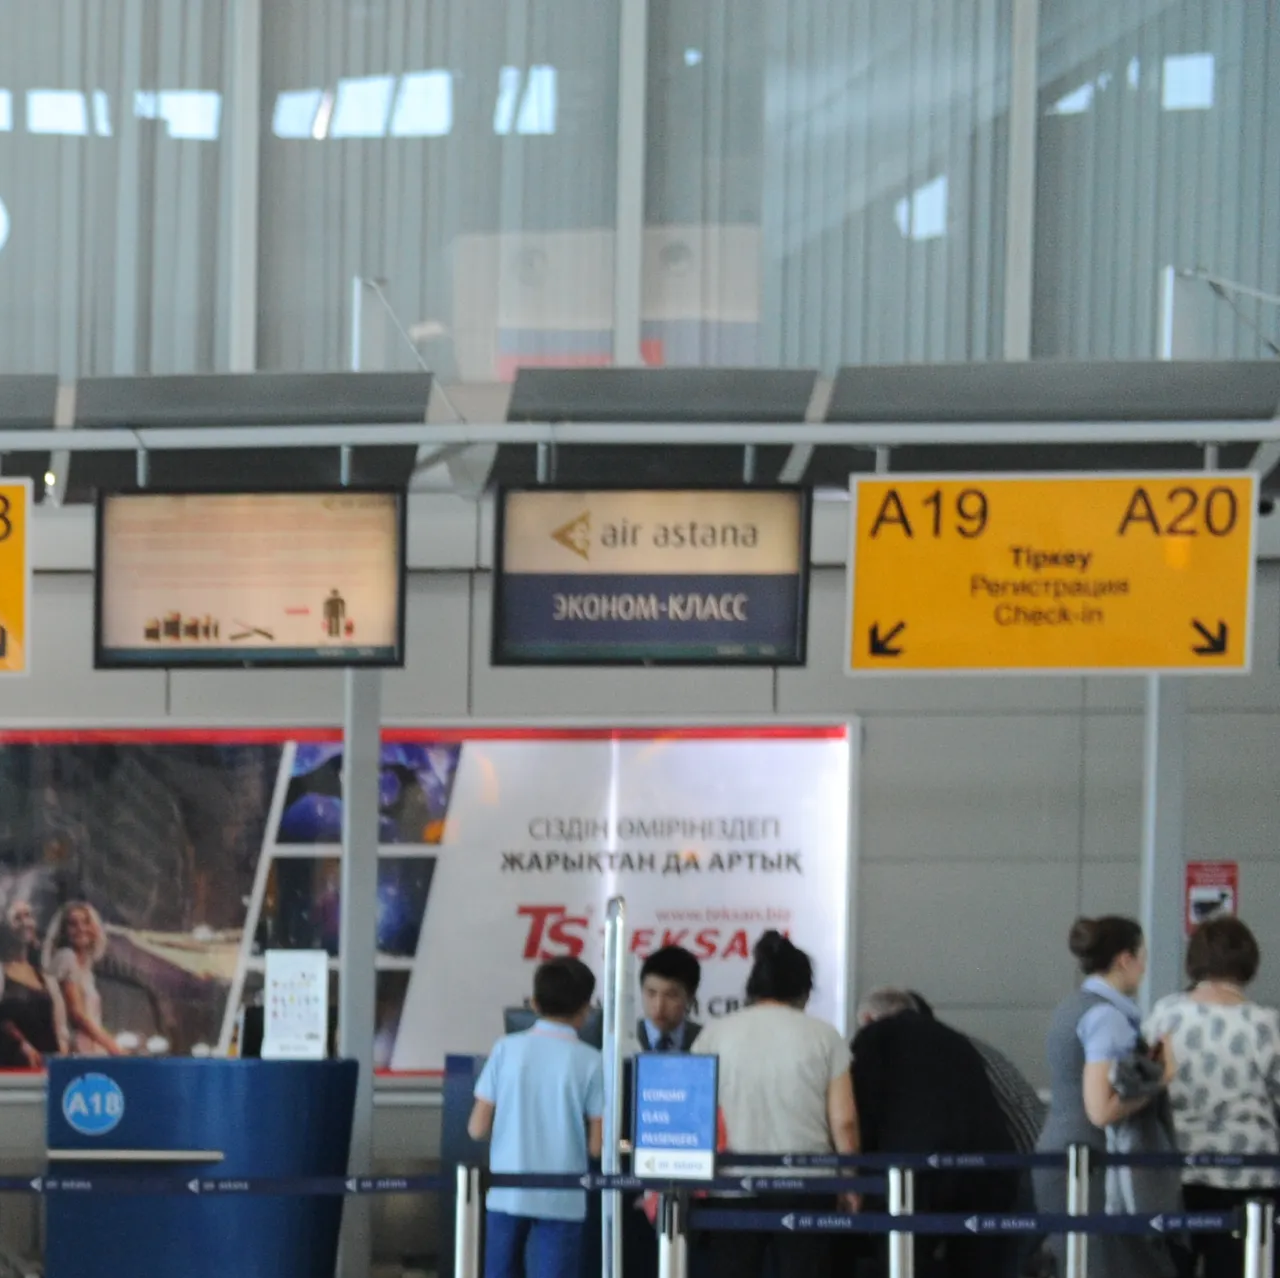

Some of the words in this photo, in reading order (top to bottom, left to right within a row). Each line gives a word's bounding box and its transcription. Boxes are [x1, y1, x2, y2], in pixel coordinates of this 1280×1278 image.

[870, 488, 990, 539] A19
[1117, 486, 1238, 537] A20
[600, 518, 642, 549] air
[652, 520, 760, 549] astana
[970, 575, 1130, 599] Регистрация
[552, 593, 748, 621] ЭКОНОМ-КЛАСС
[994, 603, 1104, 627] Check-in
[662, 851, 700, 876] ДА
[598, 927, 791, 963] EKSA
